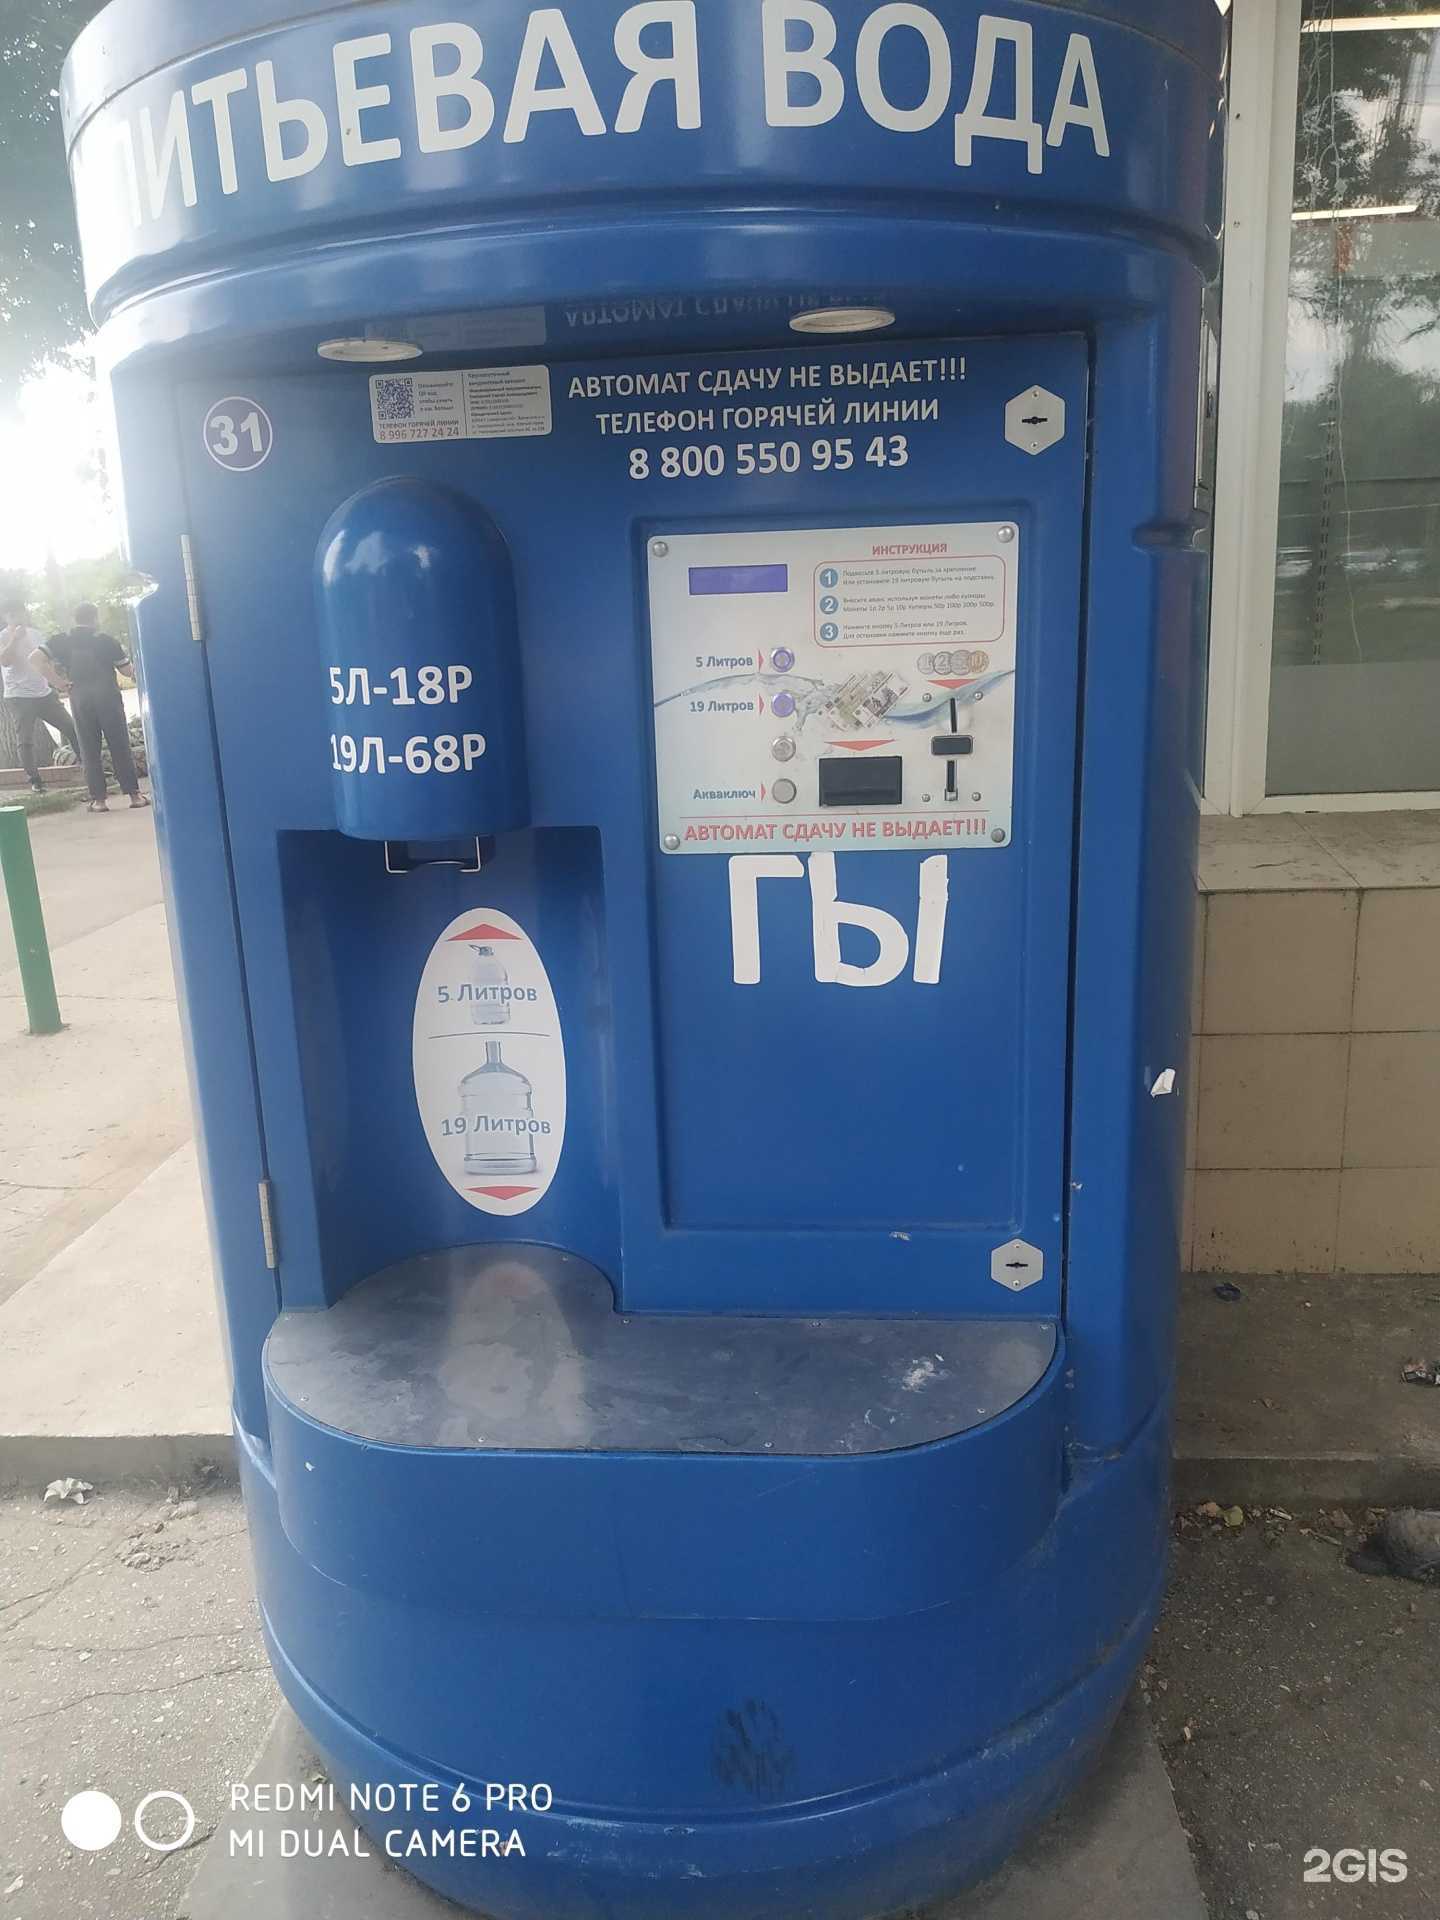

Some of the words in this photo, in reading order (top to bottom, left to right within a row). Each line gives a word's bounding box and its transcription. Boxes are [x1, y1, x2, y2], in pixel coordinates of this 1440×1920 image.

[761, 0, 1110, 174] ВОДА
[568, 371, 690, 399] АВТОМАТ
[698, 367, 782, 396] СДАЧУ
[789, 364, 821, 388] НЕ
[829, 356, 966, 389] ВЫДАЕТ!!!
[596, 408, 715, 436] ТЕЛЕФОН
[722, 398, 836, 429] ГОРЯЧЕЙ
[843, 398, 939, 424] ЛИНИИ
[210, 411, 264, 457] 31
[389, 429, 407, 439] 996
[409, 428, 428, 438] 727
[431, 427, 444, 437] 24
[447, 426, 459, 436] 24
[629, 448, 650, 480] 8
[661, 444, 725, 478] 800
[736, 441, 801, 476] 550
[811, 438, 854, 471] 95
[865, 435, 909, 467] 43
[872, 543, 948, 556] ИНСТРУКЦИЯ
[695, 655, 703, 668] 5
[706, 654, 754, 670] Литров
[329, 665, 473, 705] 5Л-18Р
[690, 699, 704, 713] 19
[706, 698, 754, 715] Литров
[330, 733, 486, 774] 19Л-68Р
[693, 787, 756, 800] Акваключ
[684, 823, 776, 842] АВТОМАТ
[782, 822, 847, 842] СДАЧУ
[852, 820, 882, 838] НЕ
[885, 817, 987, 839] ВЫДАЕТ!!!
[438, 985, 450, 1003] 5
[457, 983, 538, 1004] Литров
[441, 1117, 465, 1137] 19
[474, 1115, 551, 1137] Литров
